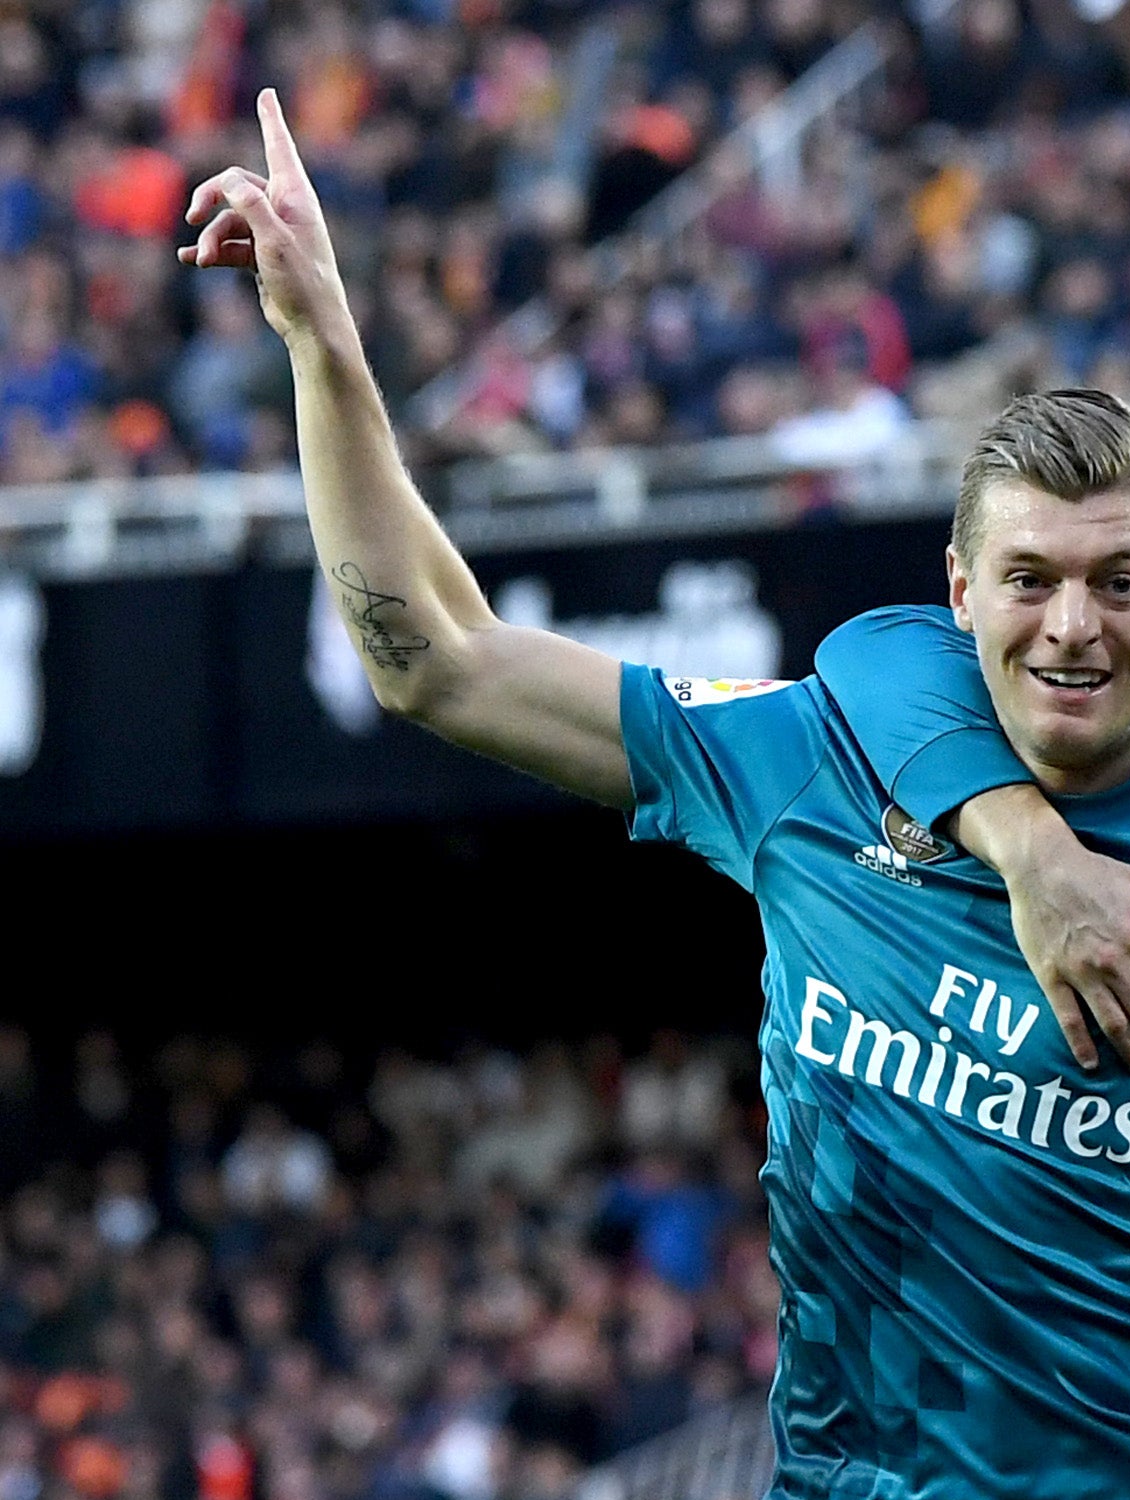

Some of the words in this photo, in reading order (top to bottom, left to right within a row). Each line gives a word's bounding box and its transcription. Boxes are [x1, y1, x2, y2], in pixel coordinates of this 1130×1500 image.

[901, 822, 934, 846] FIFA
[854, 852, 922, 887] adidas
[929, 963, 1040, 1056] Fly
